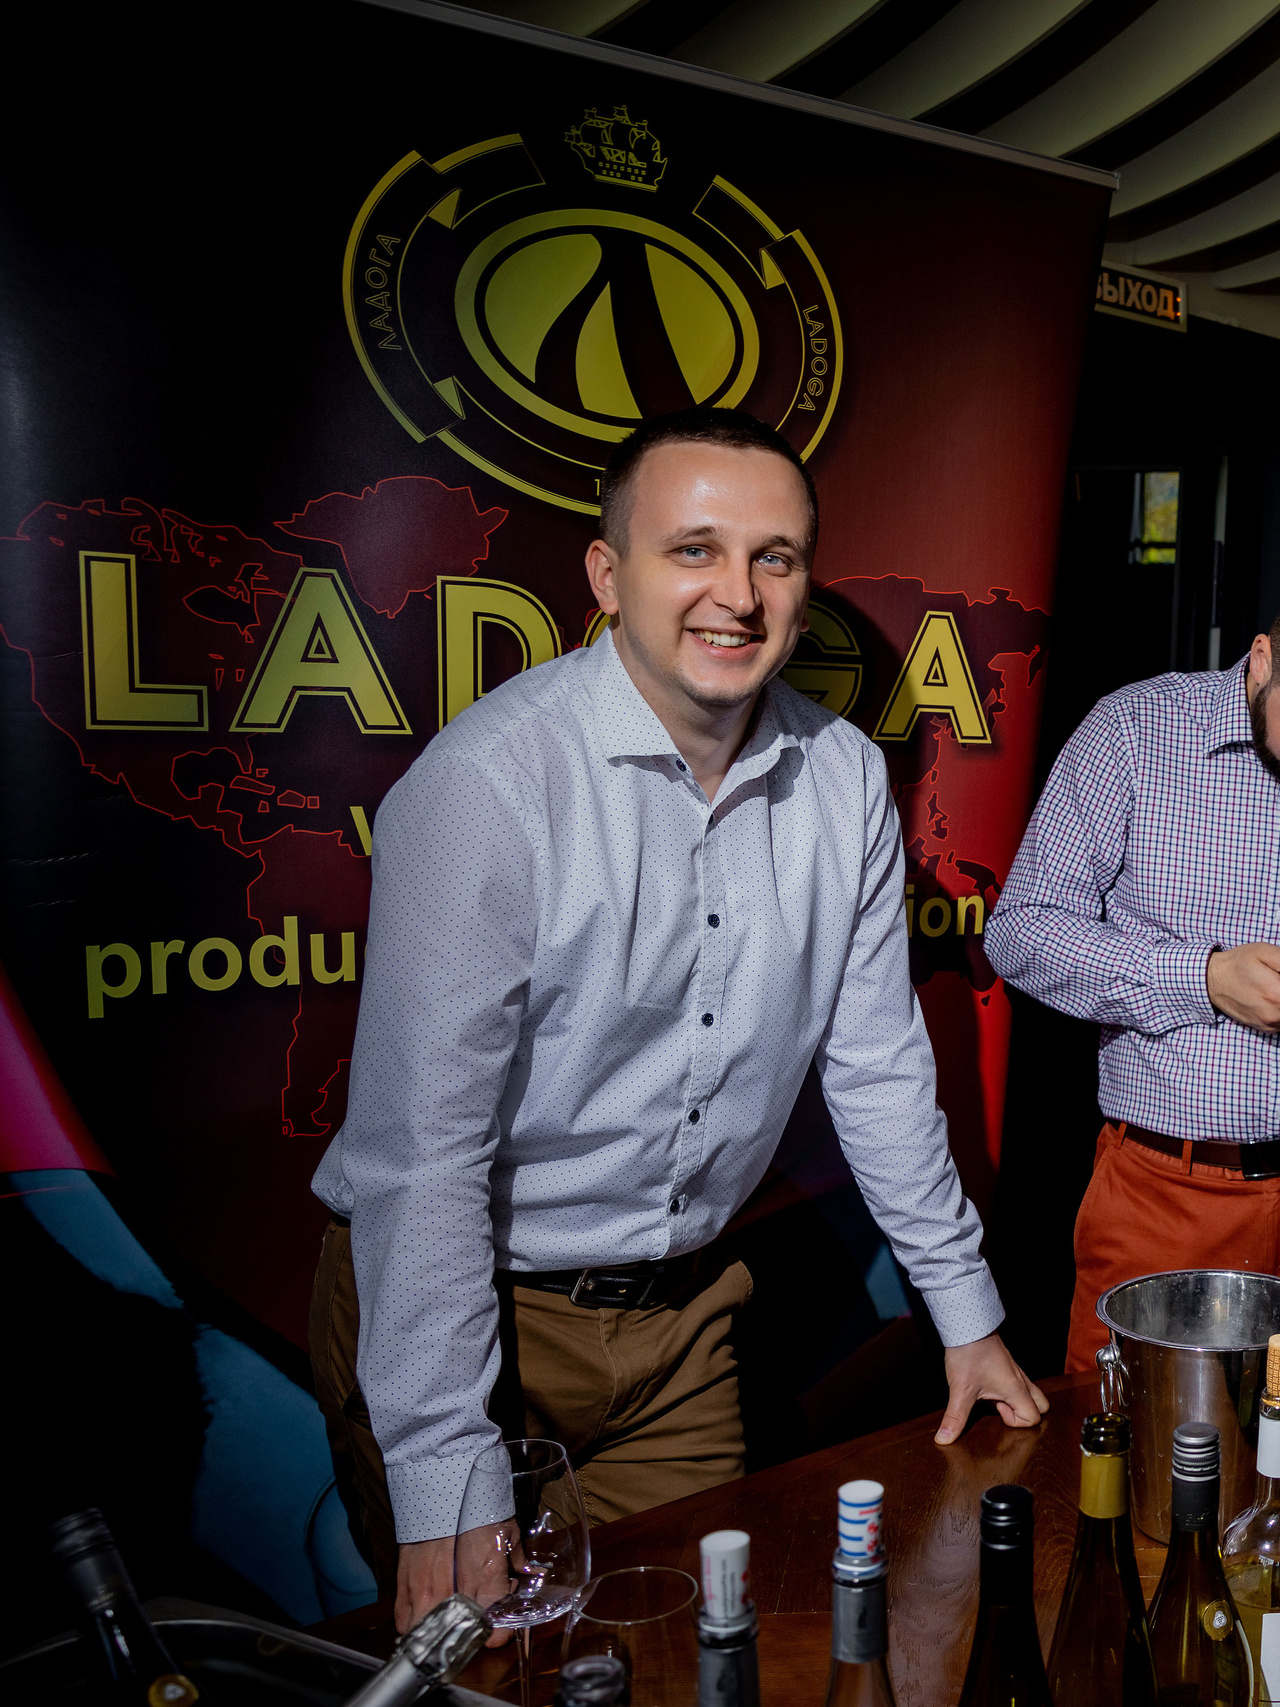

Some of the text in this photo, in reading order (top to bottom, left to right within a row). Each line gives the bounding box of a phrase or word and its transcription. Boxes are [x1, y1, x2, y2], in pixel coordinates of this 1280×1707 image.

[364, 234, 402, 351] ЛАДОГА
[801, 304, 828, 412] LADOGA
[78, 550, 992, 745] LADGA
[84, 883, 985, 1018] produ ion
